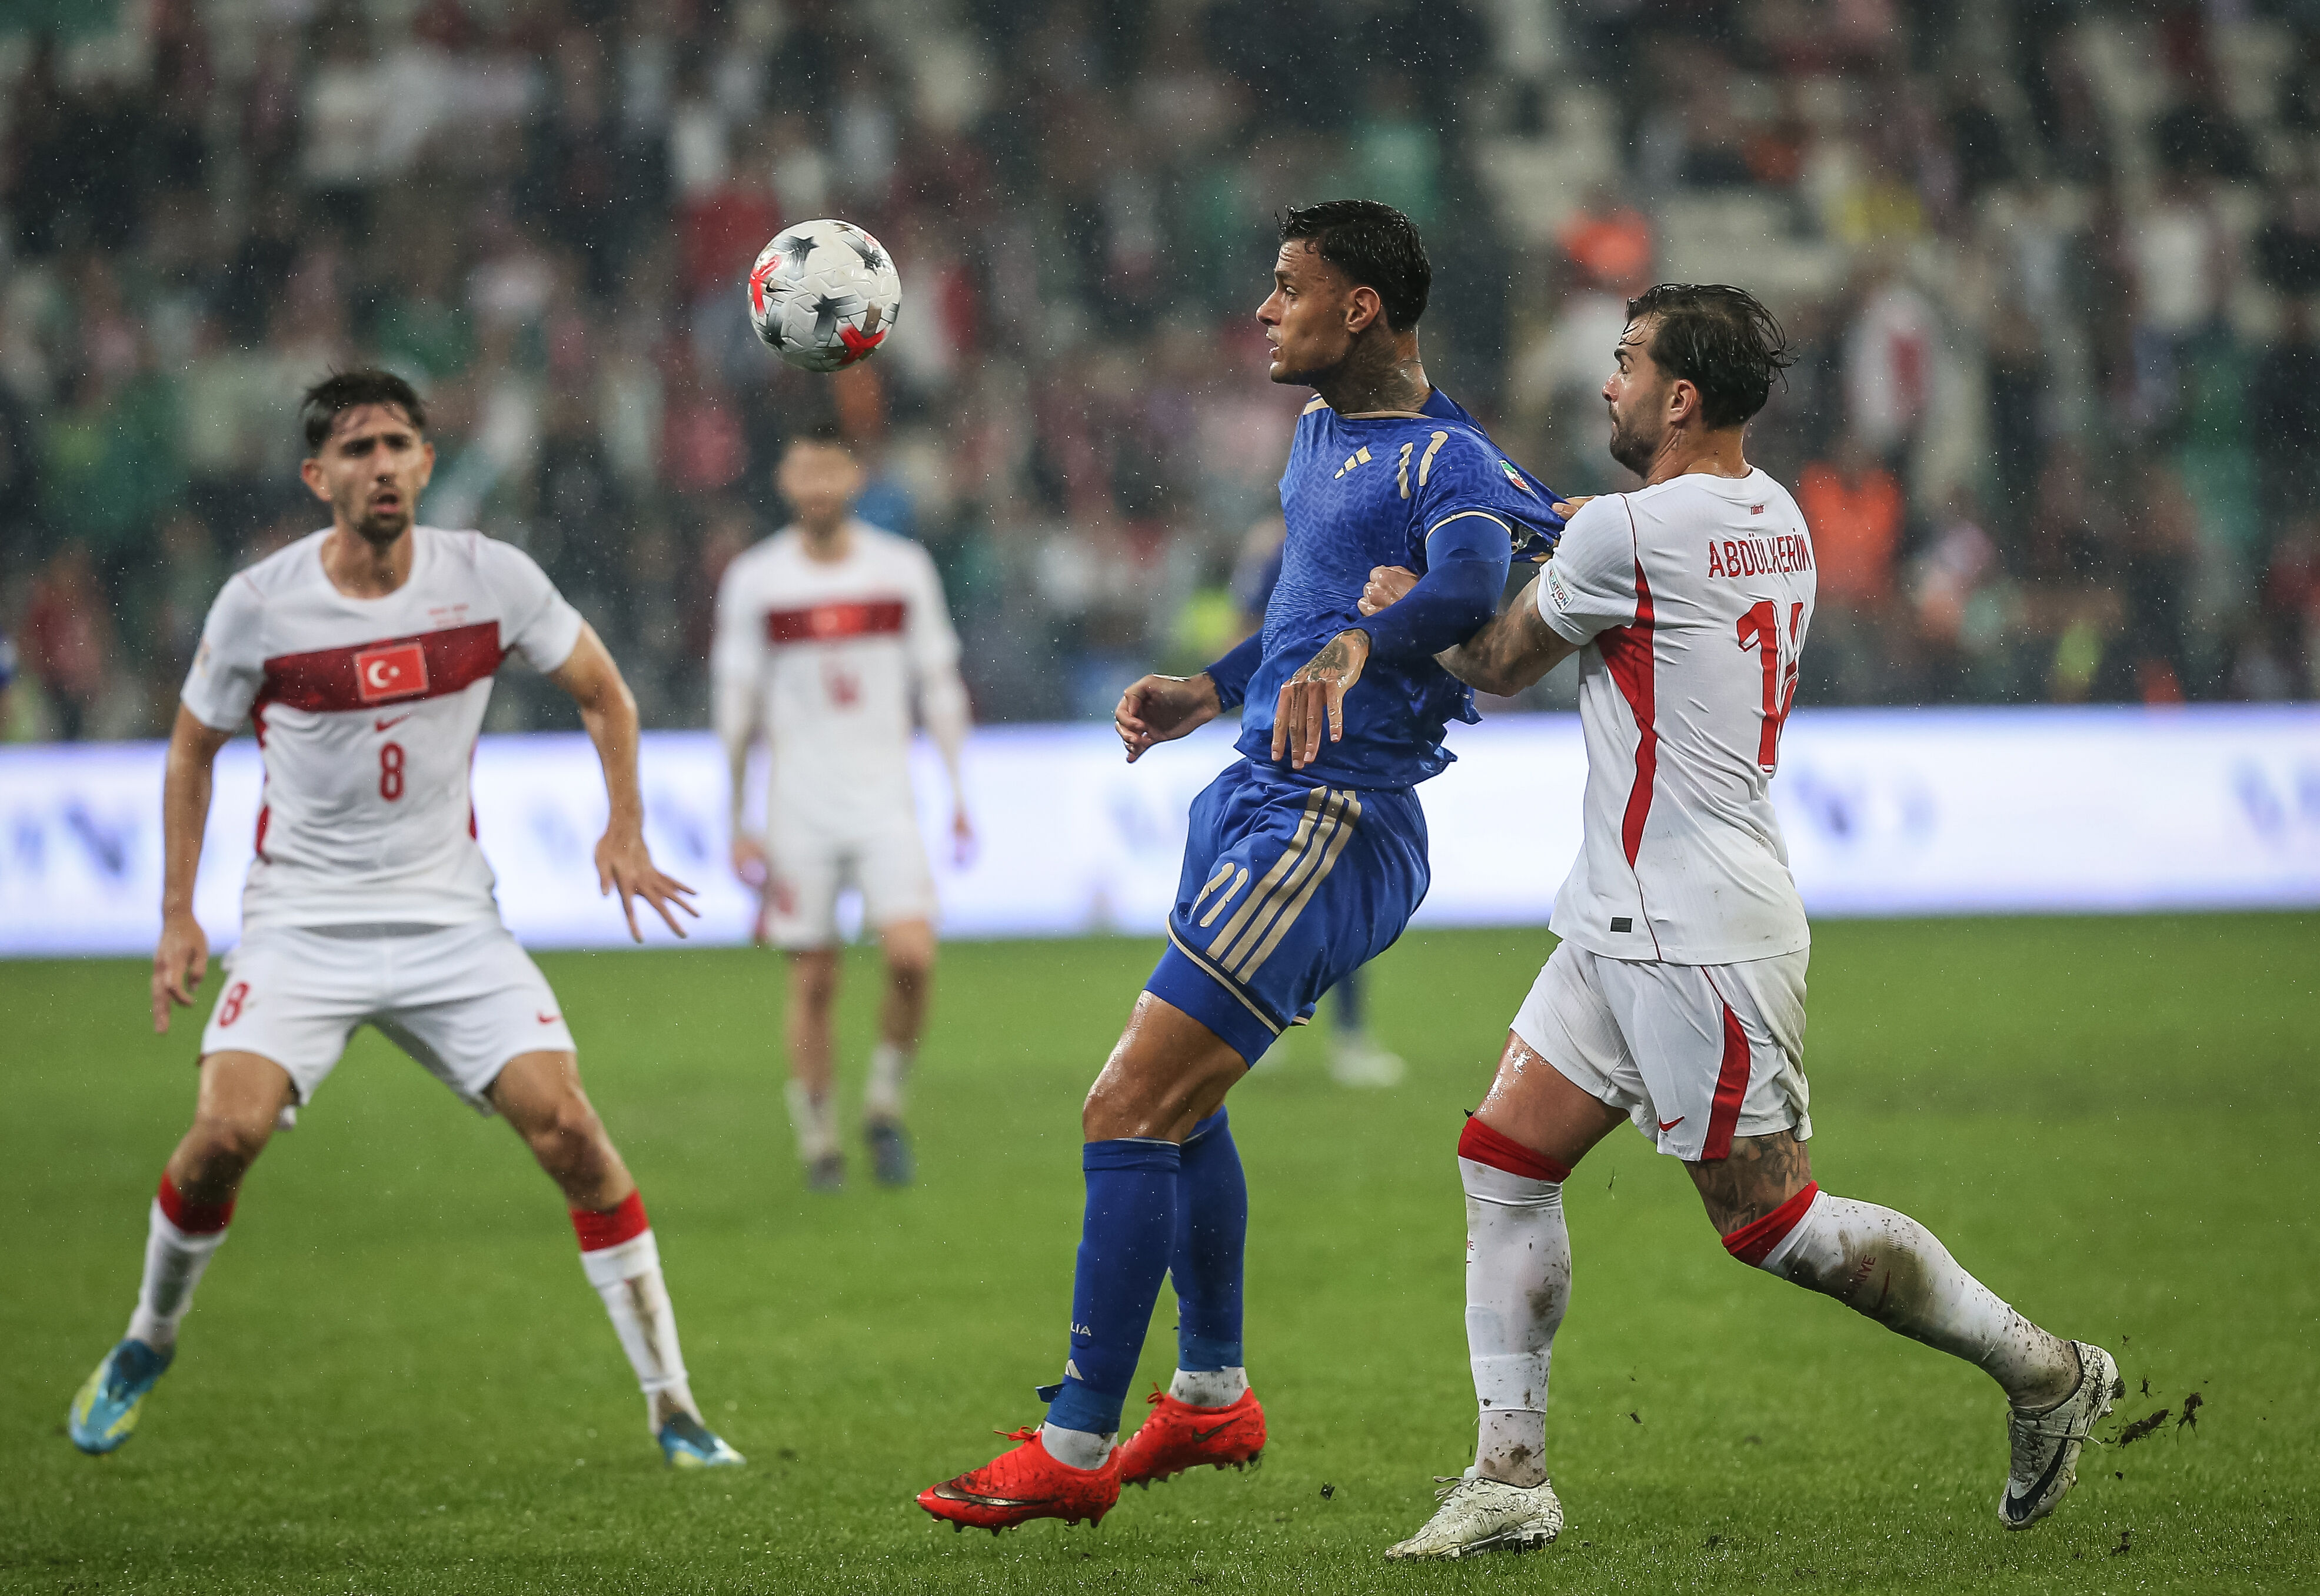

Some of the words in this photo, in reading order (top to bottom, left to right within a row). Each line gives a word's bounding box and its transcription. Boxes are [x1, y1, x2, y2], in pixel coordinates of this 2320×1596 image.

[1397, 429, 1449, 499] 11
[379, 740, 405, 802] 8
[219, 981, 251, 1028] 8
